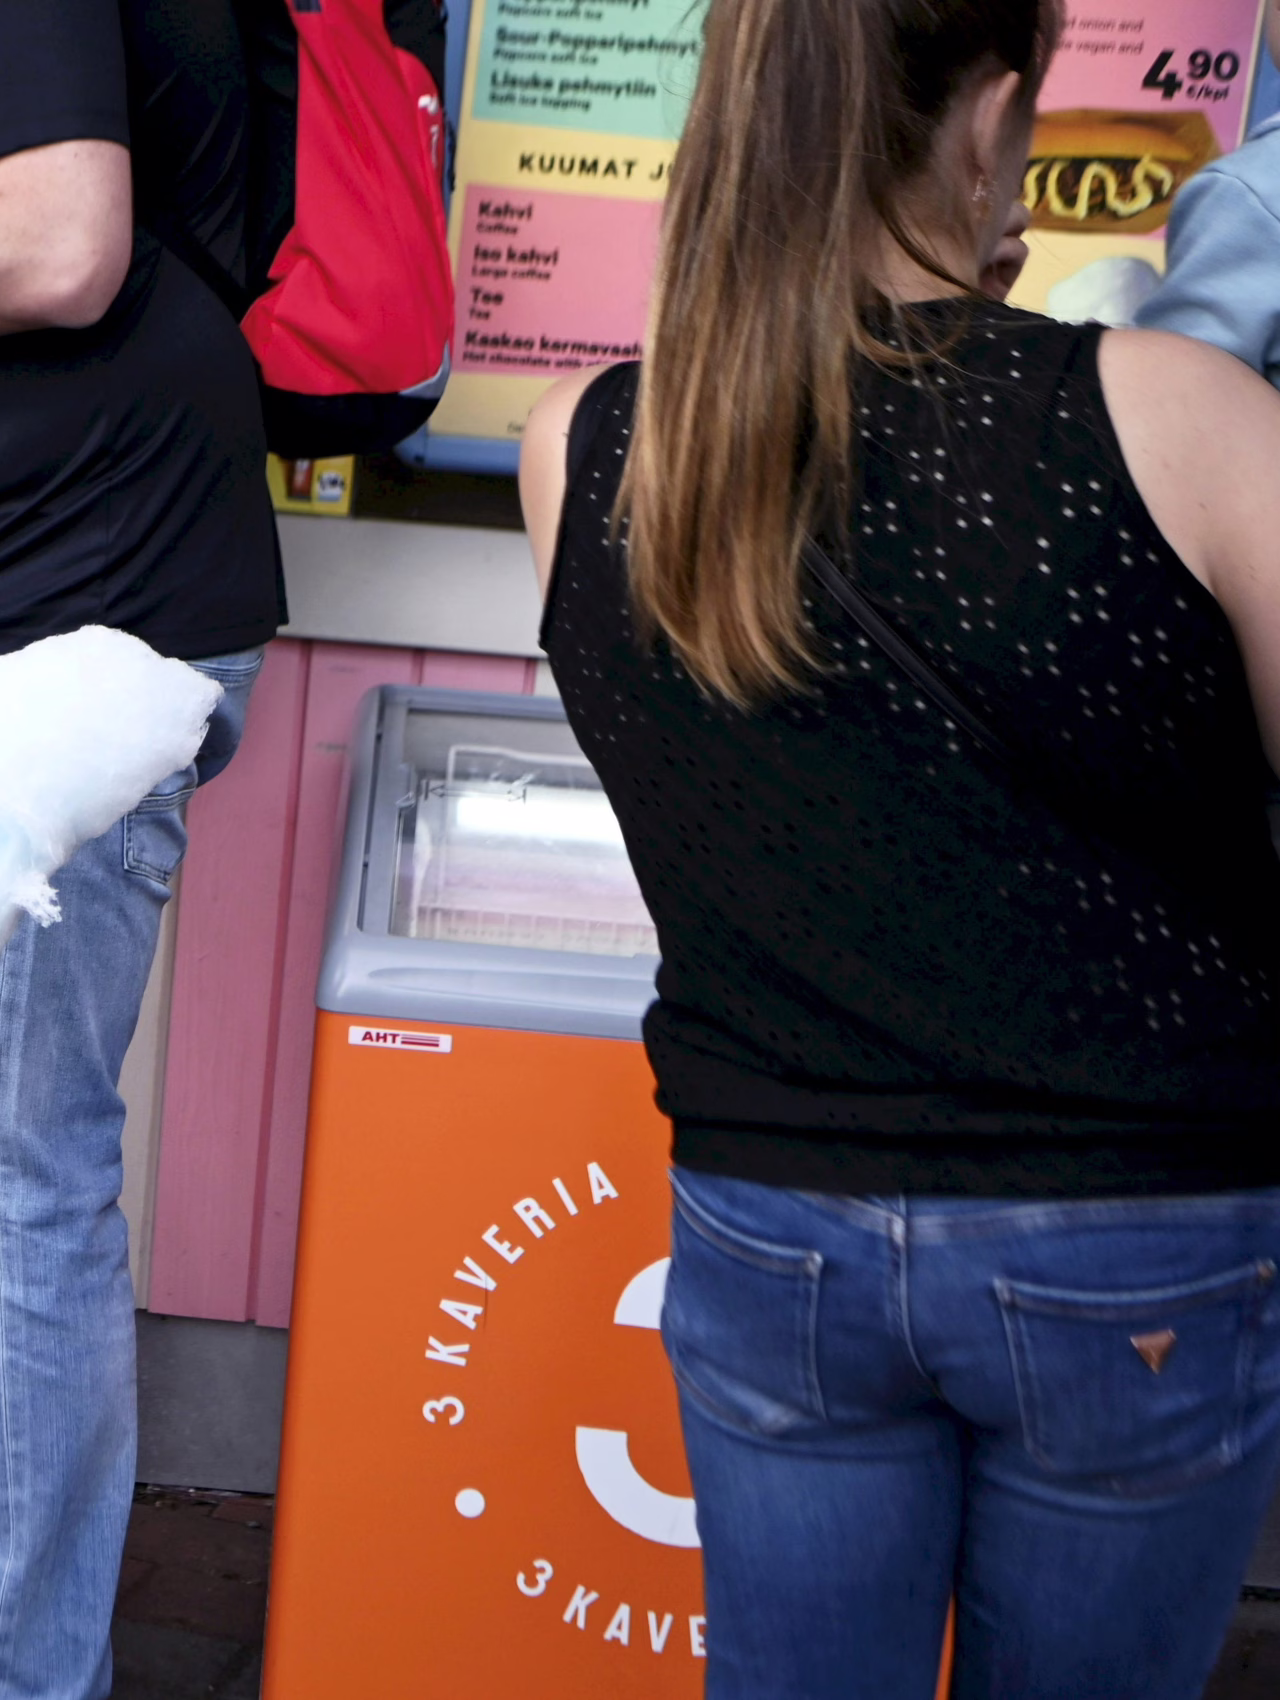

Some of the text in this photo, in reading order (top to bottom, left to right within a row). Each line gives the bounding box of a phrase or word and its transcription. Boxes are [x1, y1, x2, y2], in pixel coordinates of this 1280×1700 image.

[1118, 18, 1144, 32] and
[1076, 40, 1115, 55] vegan
[1118, 40, 1144, 54] and
[519, 153, 673, 181] KUUMAT J
[478, 201, 533, 221] Kahvi
[476, 221, 518, 235] Coffee
[506, 246, 559, 266] kahvi
[472, 265, 551, 281] Large coffee
[465, 330, 535, 351] Kaakao
[361, 1030, 400, 1046] AHT
[422, 1161, 619, 1426] 3 KAVERIA
[516, 1558, 708, 1657] 3 KAVE
